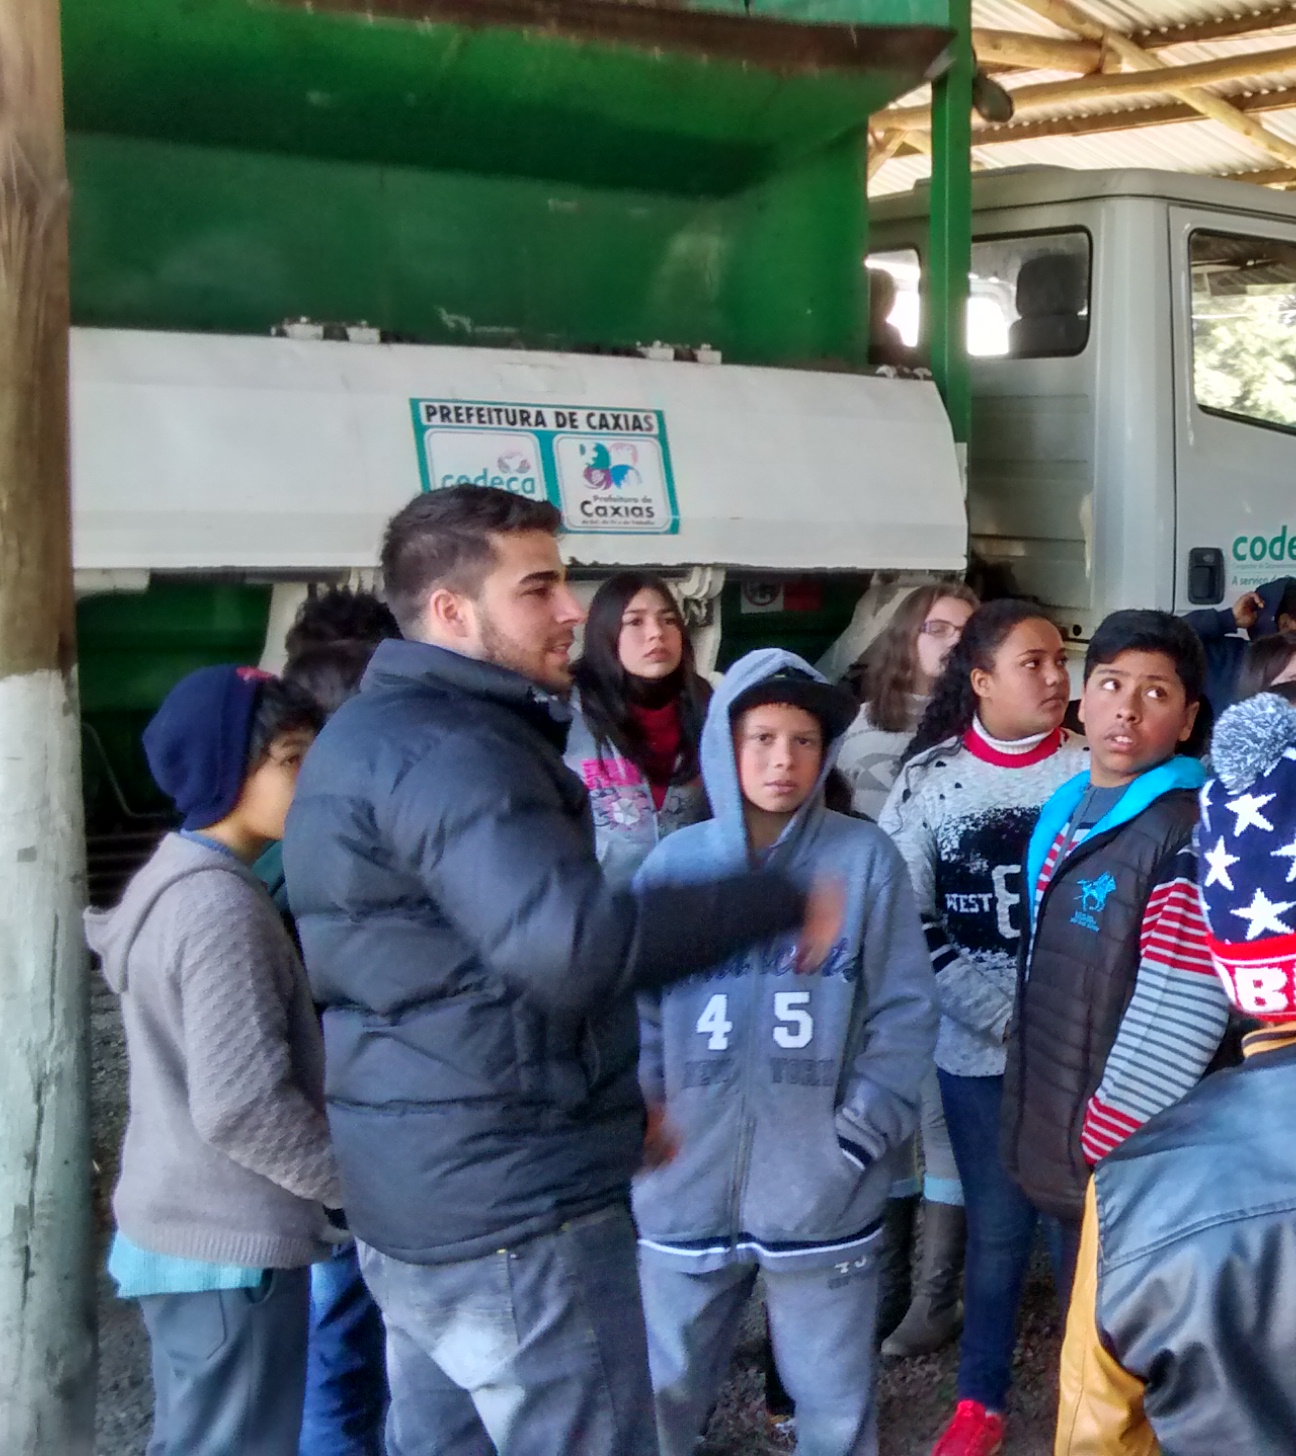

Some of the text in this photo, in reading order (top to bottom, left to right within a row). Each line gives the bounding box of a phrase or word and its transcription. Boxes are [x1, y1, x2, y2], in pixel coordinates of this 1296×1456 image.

[425, 405, 654, 432] PREFEITURA DE CAXIAS
[593, 494, 653, 504] Prefeitura de
[579, 500, 654, 519] Caxias
[1232, 576, 1238, 586] A
[946, 893, 992, 912] WEST
[696, 991, 813, 1051] 4 5
